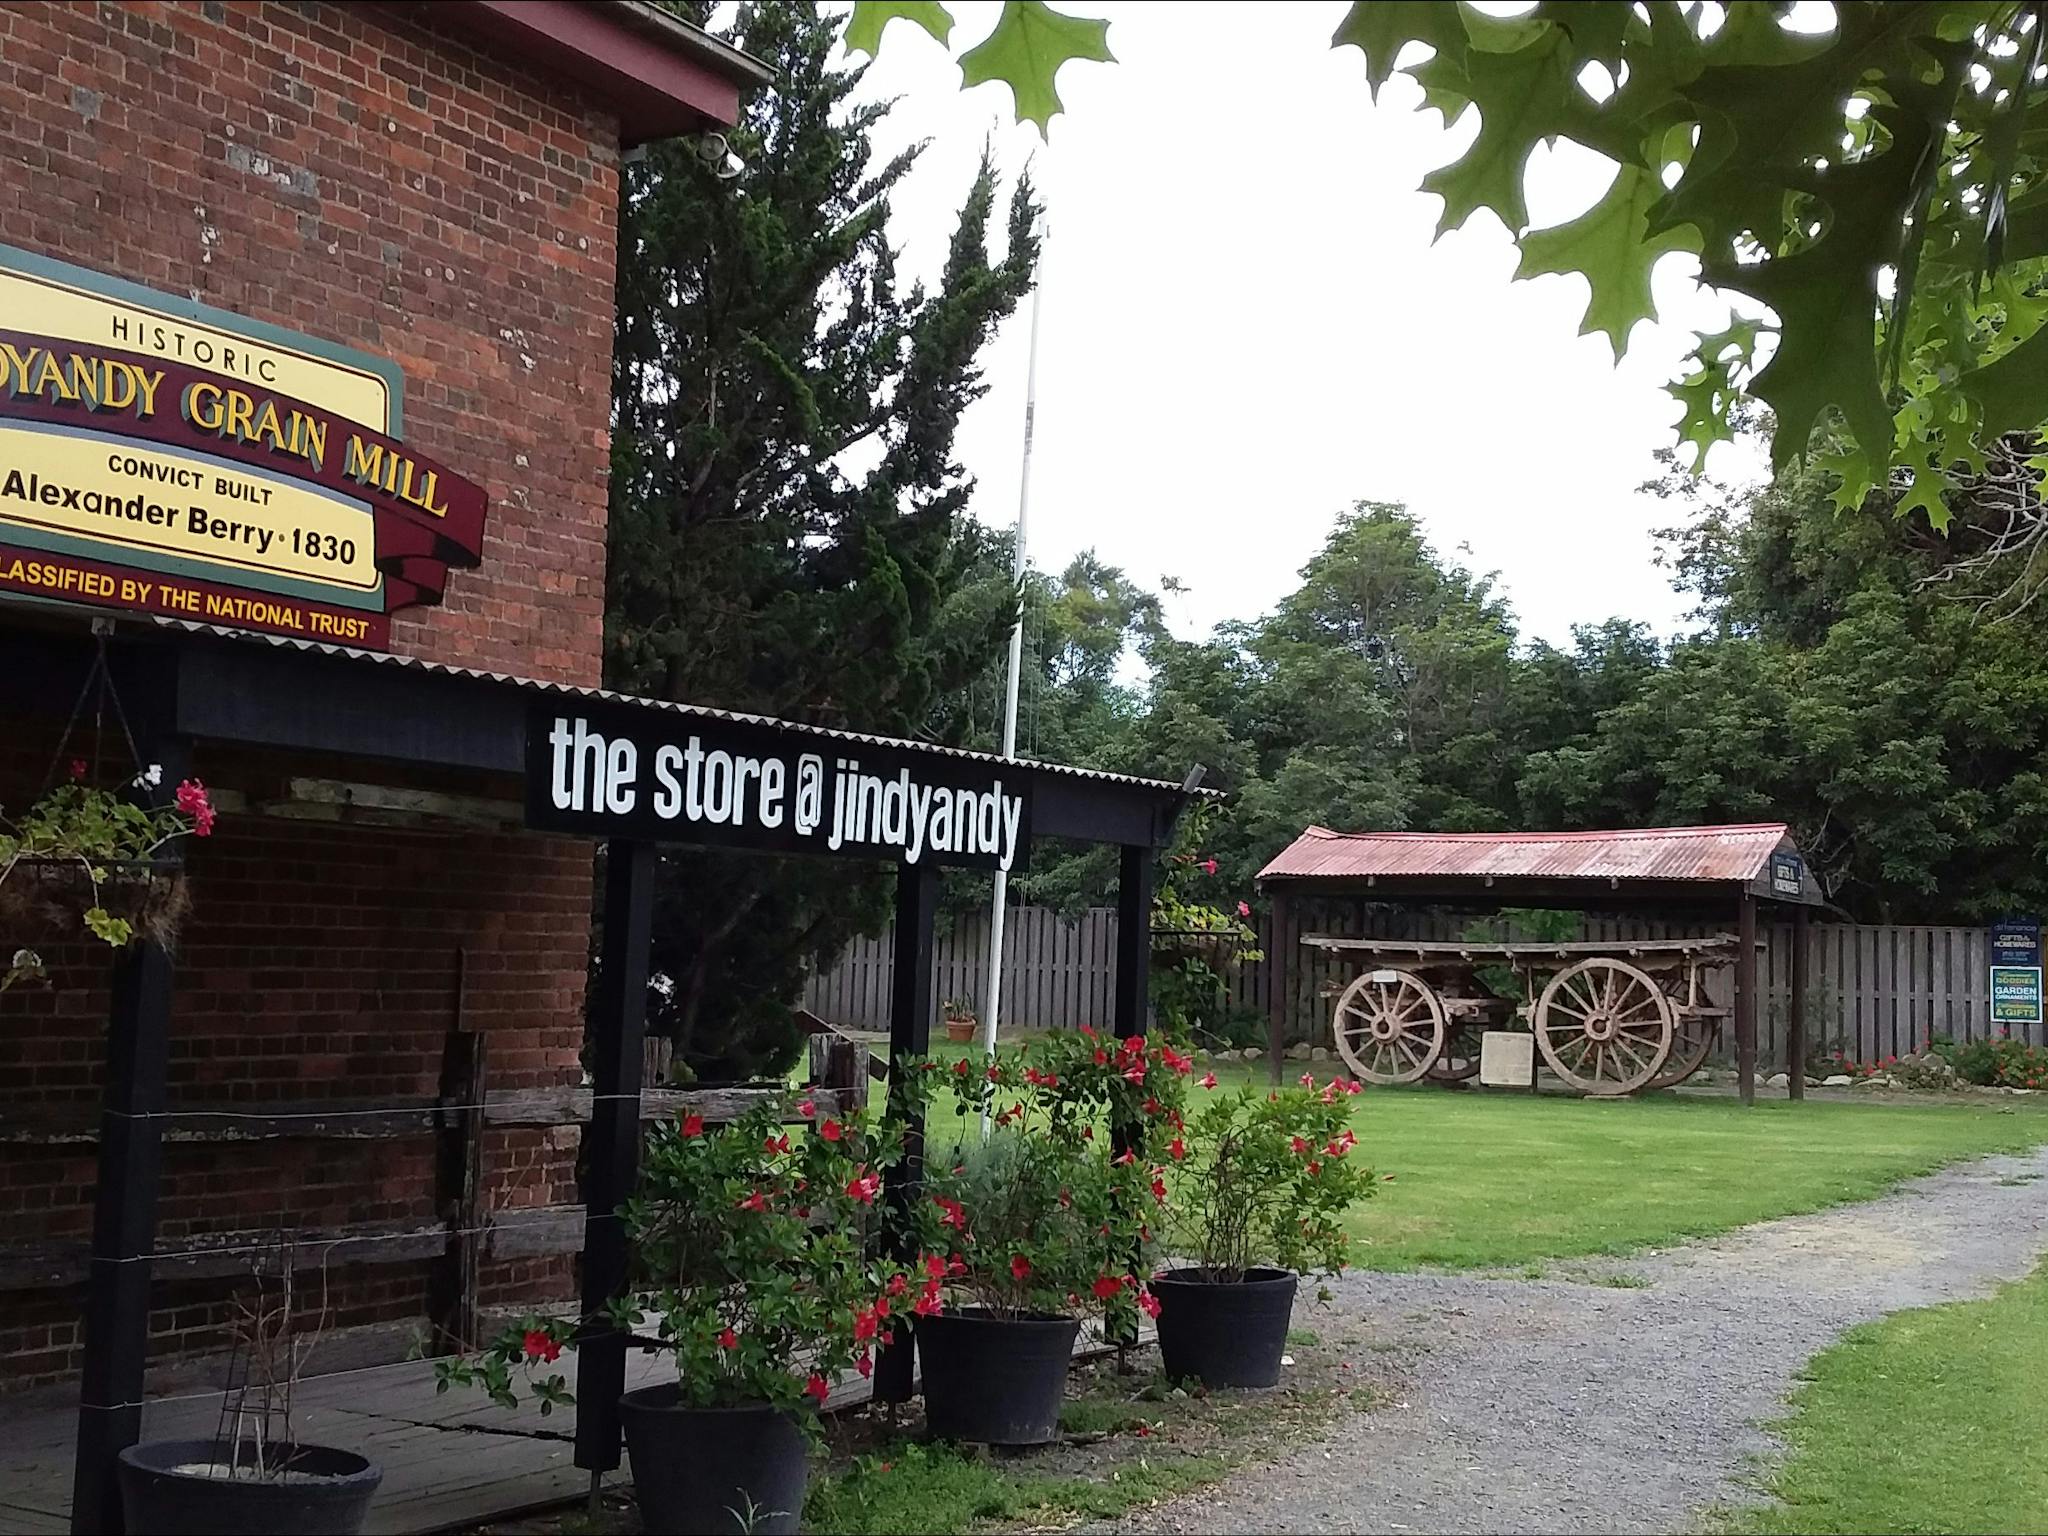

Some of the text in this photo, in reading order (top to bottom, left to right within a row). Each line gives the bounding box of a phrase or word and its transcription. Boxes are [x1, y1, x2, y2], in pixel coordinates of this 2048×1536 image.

[111, 315, 277, 382] HISTORIC
[0, 343, 449, 518] YANDY GRAIN MILL
[108, 454, 273, 506] CONVICT BUILT
[1, 469, 356, 565] Alexander Berry 1830
[120, 579, 153, 603] BY
[158, 585, 201, 612] THE
[205, 594, 304, 630] NATIONAL
[308, 611, 370, 640] TRUST
[549, 717, 1022, 872] the store @ jindyandy
[1995, 986, 2037, 995] GARDEN
[1995, 1008, 2036, 1018] & GIFTS
